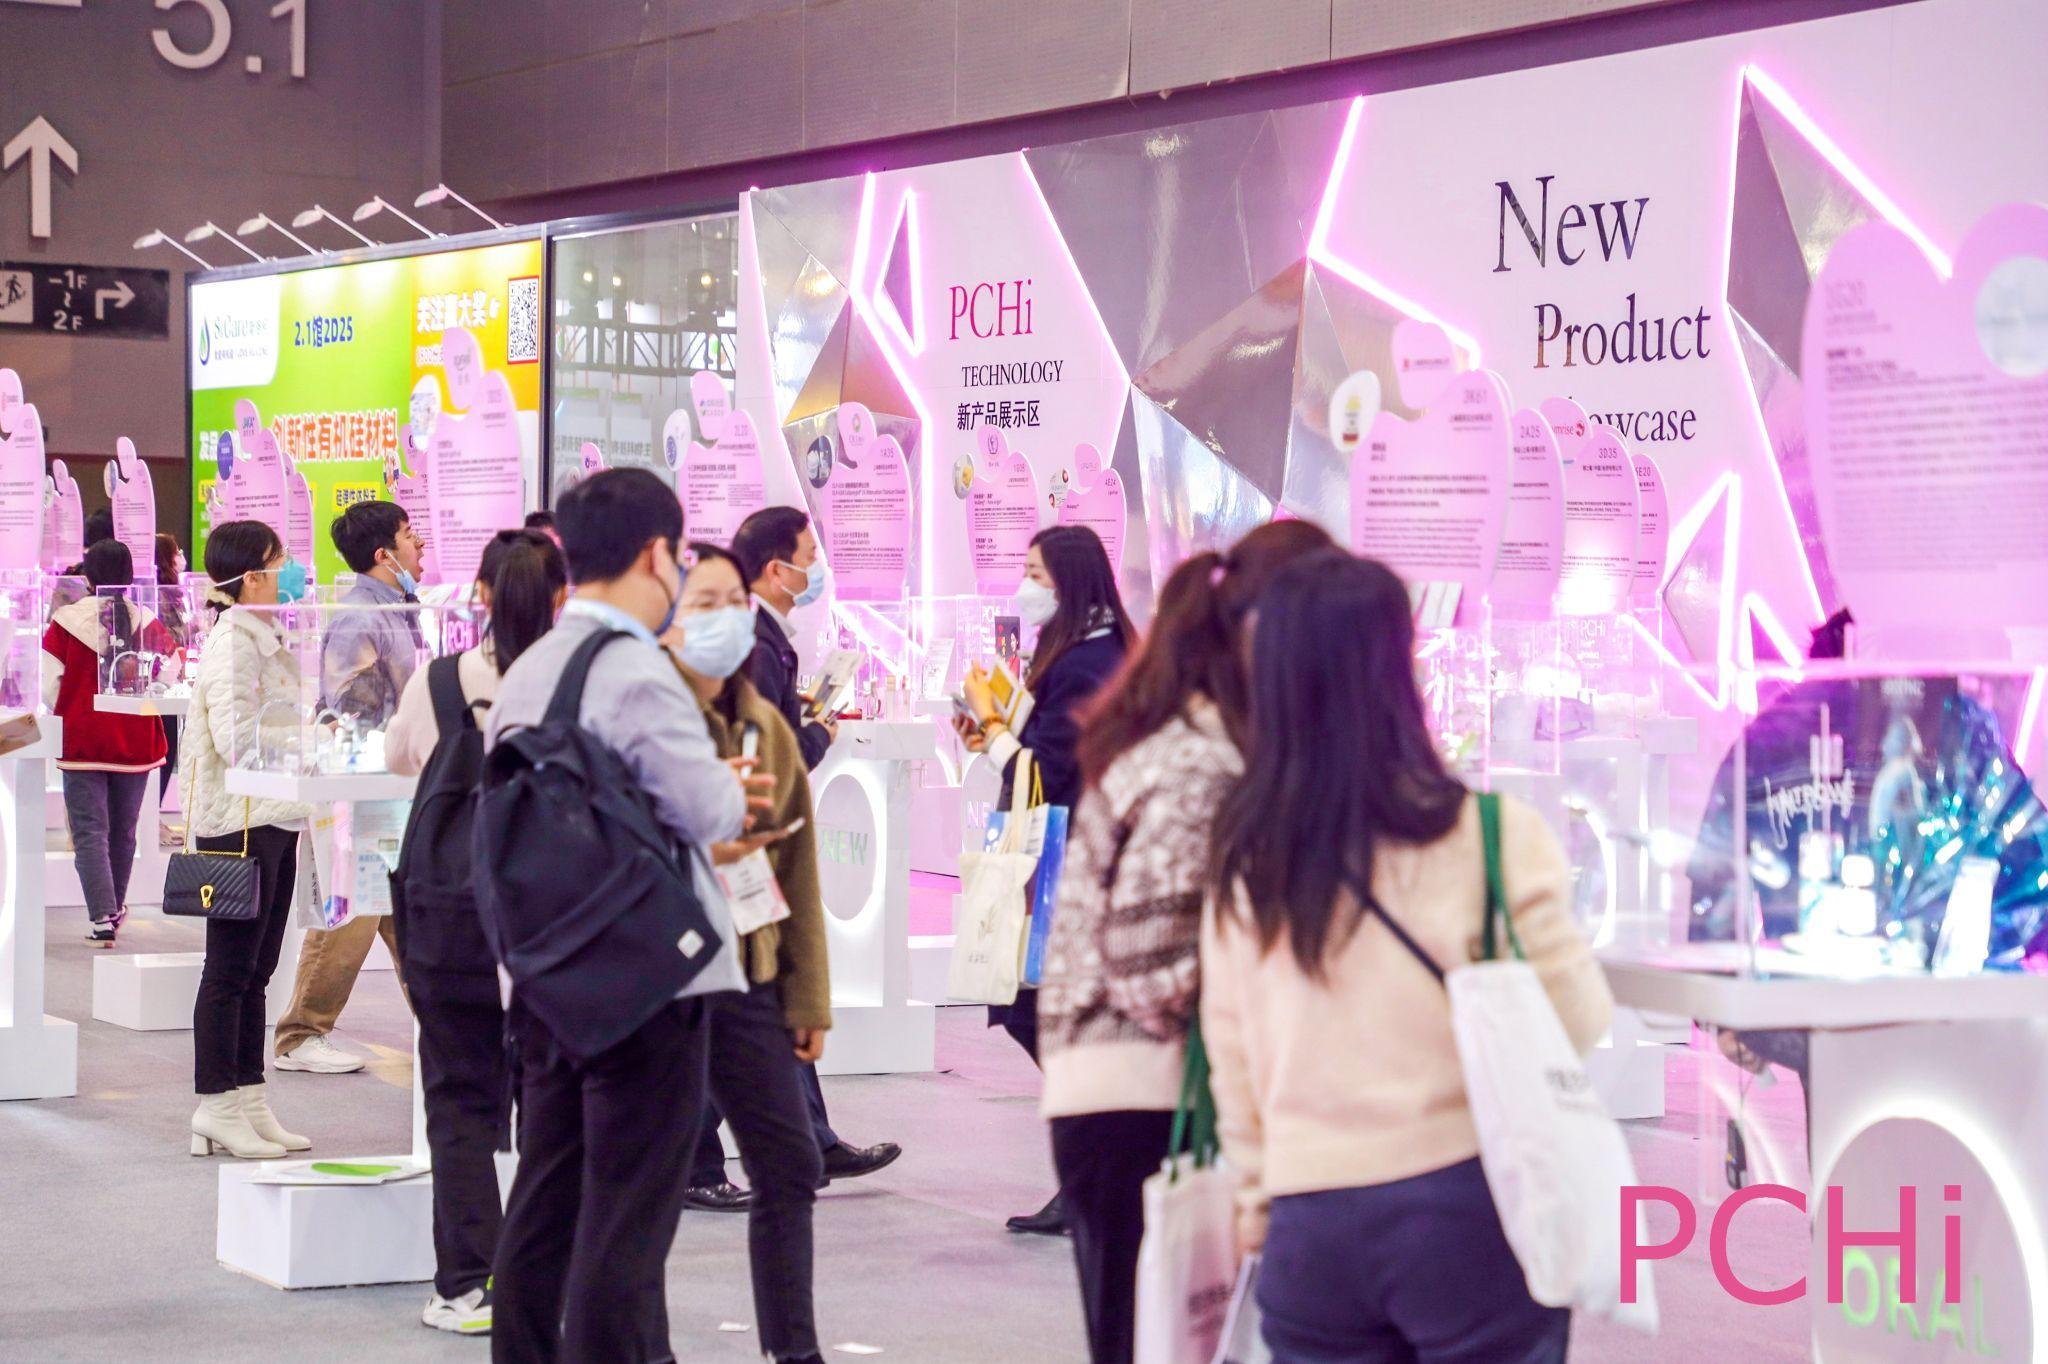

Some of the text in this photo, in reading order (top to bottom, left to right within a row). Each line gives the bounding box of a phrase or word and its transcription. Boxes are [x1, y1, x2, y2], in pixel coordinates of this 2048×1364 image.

[1493, 175, 1650, 272] New
[53, 310, 83, 330] 2F
[949, 278, 1033, 341] PCHi
[1533, 293, 1711, 369] Product
[961, 360, 1064, 388] TECHNOLOGY
[957, 400, 1041, 431] 新产品展示区
[822, 830, 868, 866] NEW
